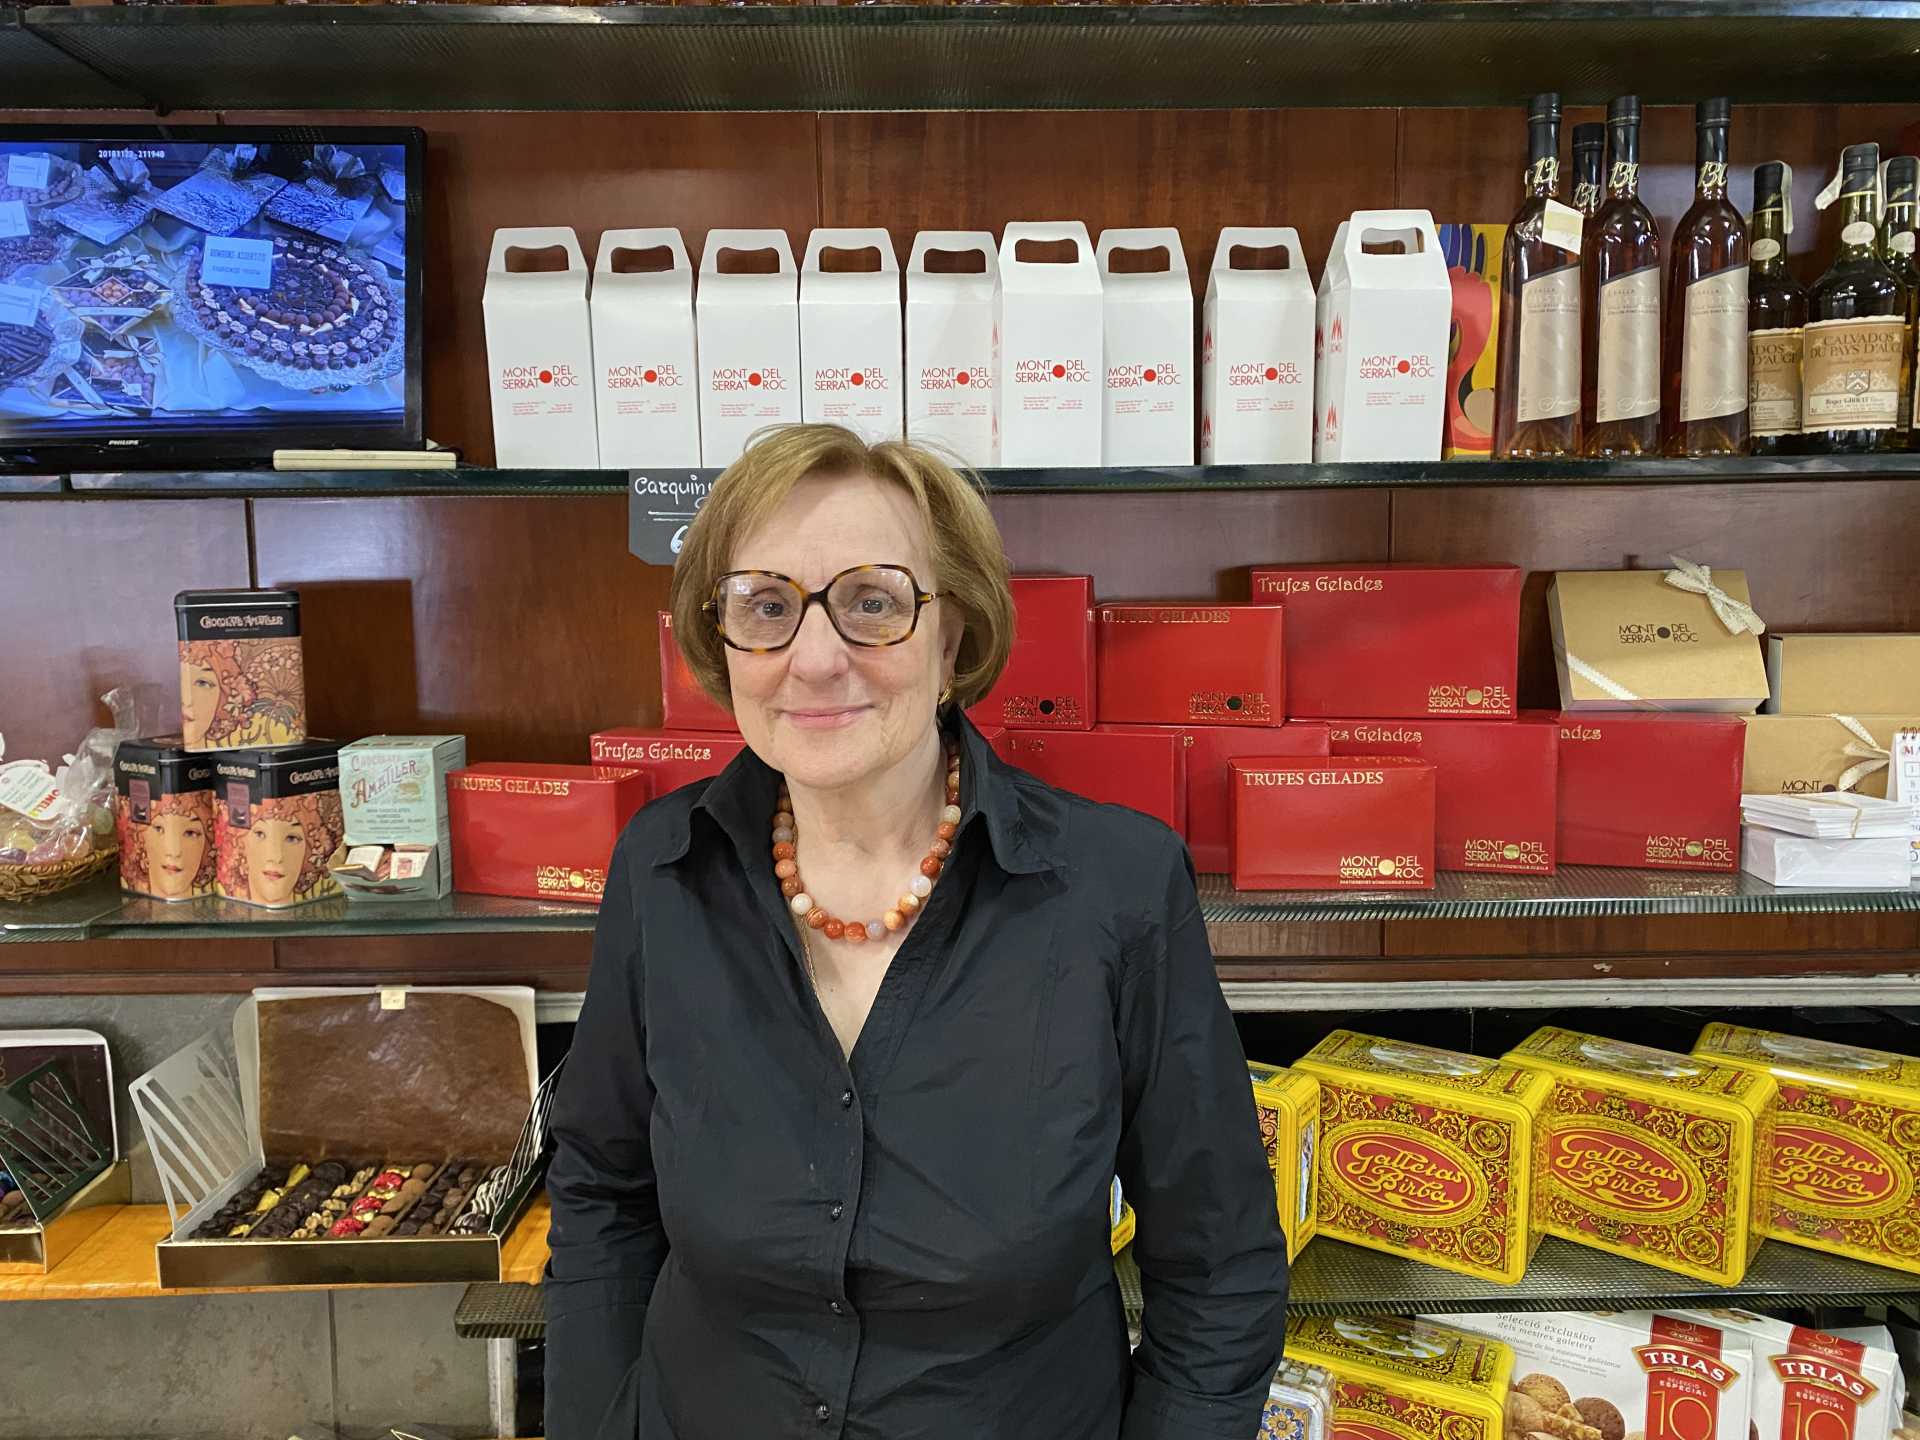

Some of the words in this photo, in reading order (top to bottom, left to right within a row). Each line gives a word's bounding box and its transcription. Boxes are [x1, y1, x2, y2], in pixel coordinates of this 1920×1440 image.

[1824, 333, 1894, 346] CALVADOS
[1810, 348, 1826, 359] DU
[1830, 345, 1861, 357] PAYS
[1016, 360, 1052, 371] MONT
[1066, 360, 1085, 371] DEL
[1230, 363, 1265, 374] MONT
[1278, 363, 1297, 372] DEL
[1361, 355, 1398, 368] MONT
[1411, 355, 1431, 367] DEL
[503, 366, 538, 378] MONT
[552, 365, 573, 376] DEL
[608, 366, 643, 378] MONT
[657, 365, 678, 376] DEL
[712, 368, 748, 379] MONT
[762, 368, 782, 379] DEL
[815, 368, 850, 379] MONT
[864, 367, 884, 378] DEL
[921, 367, 956, 378] MONT
[970, 367, 989, 378] DEL
[1015, 372, 1052, 382] SERRAT
[1066, 372, 1091, 382] ROC
[1108, 364, 1144, 377] MONT
[1157, 363, 1177, 374] DEL
[1359, 367, 1399, 379] SERRAT
[1410, 366, 1436, 378] ROC
[503, 378, 539, 389] SERRAT
[554, 375, 579, 387] ROC
[608, 377, 644, 389] SERRAT
[658, 375, 683, 387] ROC
[712, 380, 749, 391] SERRAT
[762, 380, 787, 390] ROC
[815, 380, 851, 391] SERRAT
[864, 379, 889, 389] ROC
[920, 379, 956, 390] SERRAT
[1107, 376, 1144, 389] SERRAT
[1157, 374, 1181, 385] ROC
[1229, 375, 1265, 386] SERRAT
[1278, 374, 1303, 384] ROC
[1258, 576, 1310, 596] Trufes
[1315, 576, 1383, 592] Gelades
[1160, 610, 1232, 624] GELADES
[1618, 623, 1655, 635] MONT
[1671, 623, 1691, 634] DEL
[1619, 634, 1657, 644] SERRAT
[1672, 632, 1699, 643] ROC
[1190, 692, 1226, 702] MONT
[1243, 692, 1265, 703] DEL
[1428, 686, 1468, 697] MONT
[1483, 686, 1508, 697] DEL
[1190, 703, 1226, 714] SERRAT
[1243, 703, 1270, 715] ROC
[1428, 697, 1466, 708] SERRAT
[1482, 697, 1511, 708] ROC
[1355, 727, 1422, 743] Gelades
[1561, 724, 1602, 740] ades
[595, 742, 644, 761] Trufes
[649, 743, 712, 761] Gelades
[1243, 772, 1304, 786] TRUFES
[1308, 771, 1384, 785] GELADES
[1781, 780, 1821, 791] MONT
[454, 777, 502, 792] TRUFES
[504, 779, 569, 796] GELADES
[1464, 839, 1505, 851] MONT
[1520, 841, 1545, 853] DEL
[1646, 835, 1687, 848] MONT
[1704, 838, 1729, 850] DEL
[1464, 850, 1504, 862] SERRAT
[1520, 852, 1549, 864] ROC
[1646, 847, 1686, 859] SERRAT
[1703, 849, 1733, 861] ROC
[1340, 856, 1381, 867] MONT
[1396, 856, 1420, 867] DEL
[537, 865, 571, 878] MONT
[584, 868, 607, 881] DEL
[1340, 867, 1378, 878] SERRAT
[1395, 867, 1424, 878] ROC
[537, 877, 569, 890] SERRAT
[585, 880, 605, 893] RO
[1346, 1139, 1463, 1183] Galletas
[1556, 1135, 1683, 1184] Galletas
[1776, 1138, 1890, 1177] alletas
[1569, 1159, 1671, 1204] Birba
[1771, 1156, 1875, 1200] Birba
[1359, 1164, 1455, 1207] Birba
[1496, 1313, 1541, 1329] Selecció
[1544, 1324, 1597, 1344] exclusiva
[1519, 1327, 1553, 1341] mestres
[1645, 1352, 1726, 1382] TRIAS
[1781, 1362, 1865, 1396] TRIAS
[1659, 1380, 1708, 1397] ESPECIAL
[1796, 1391, 1845, 1411] ESPECIAL
